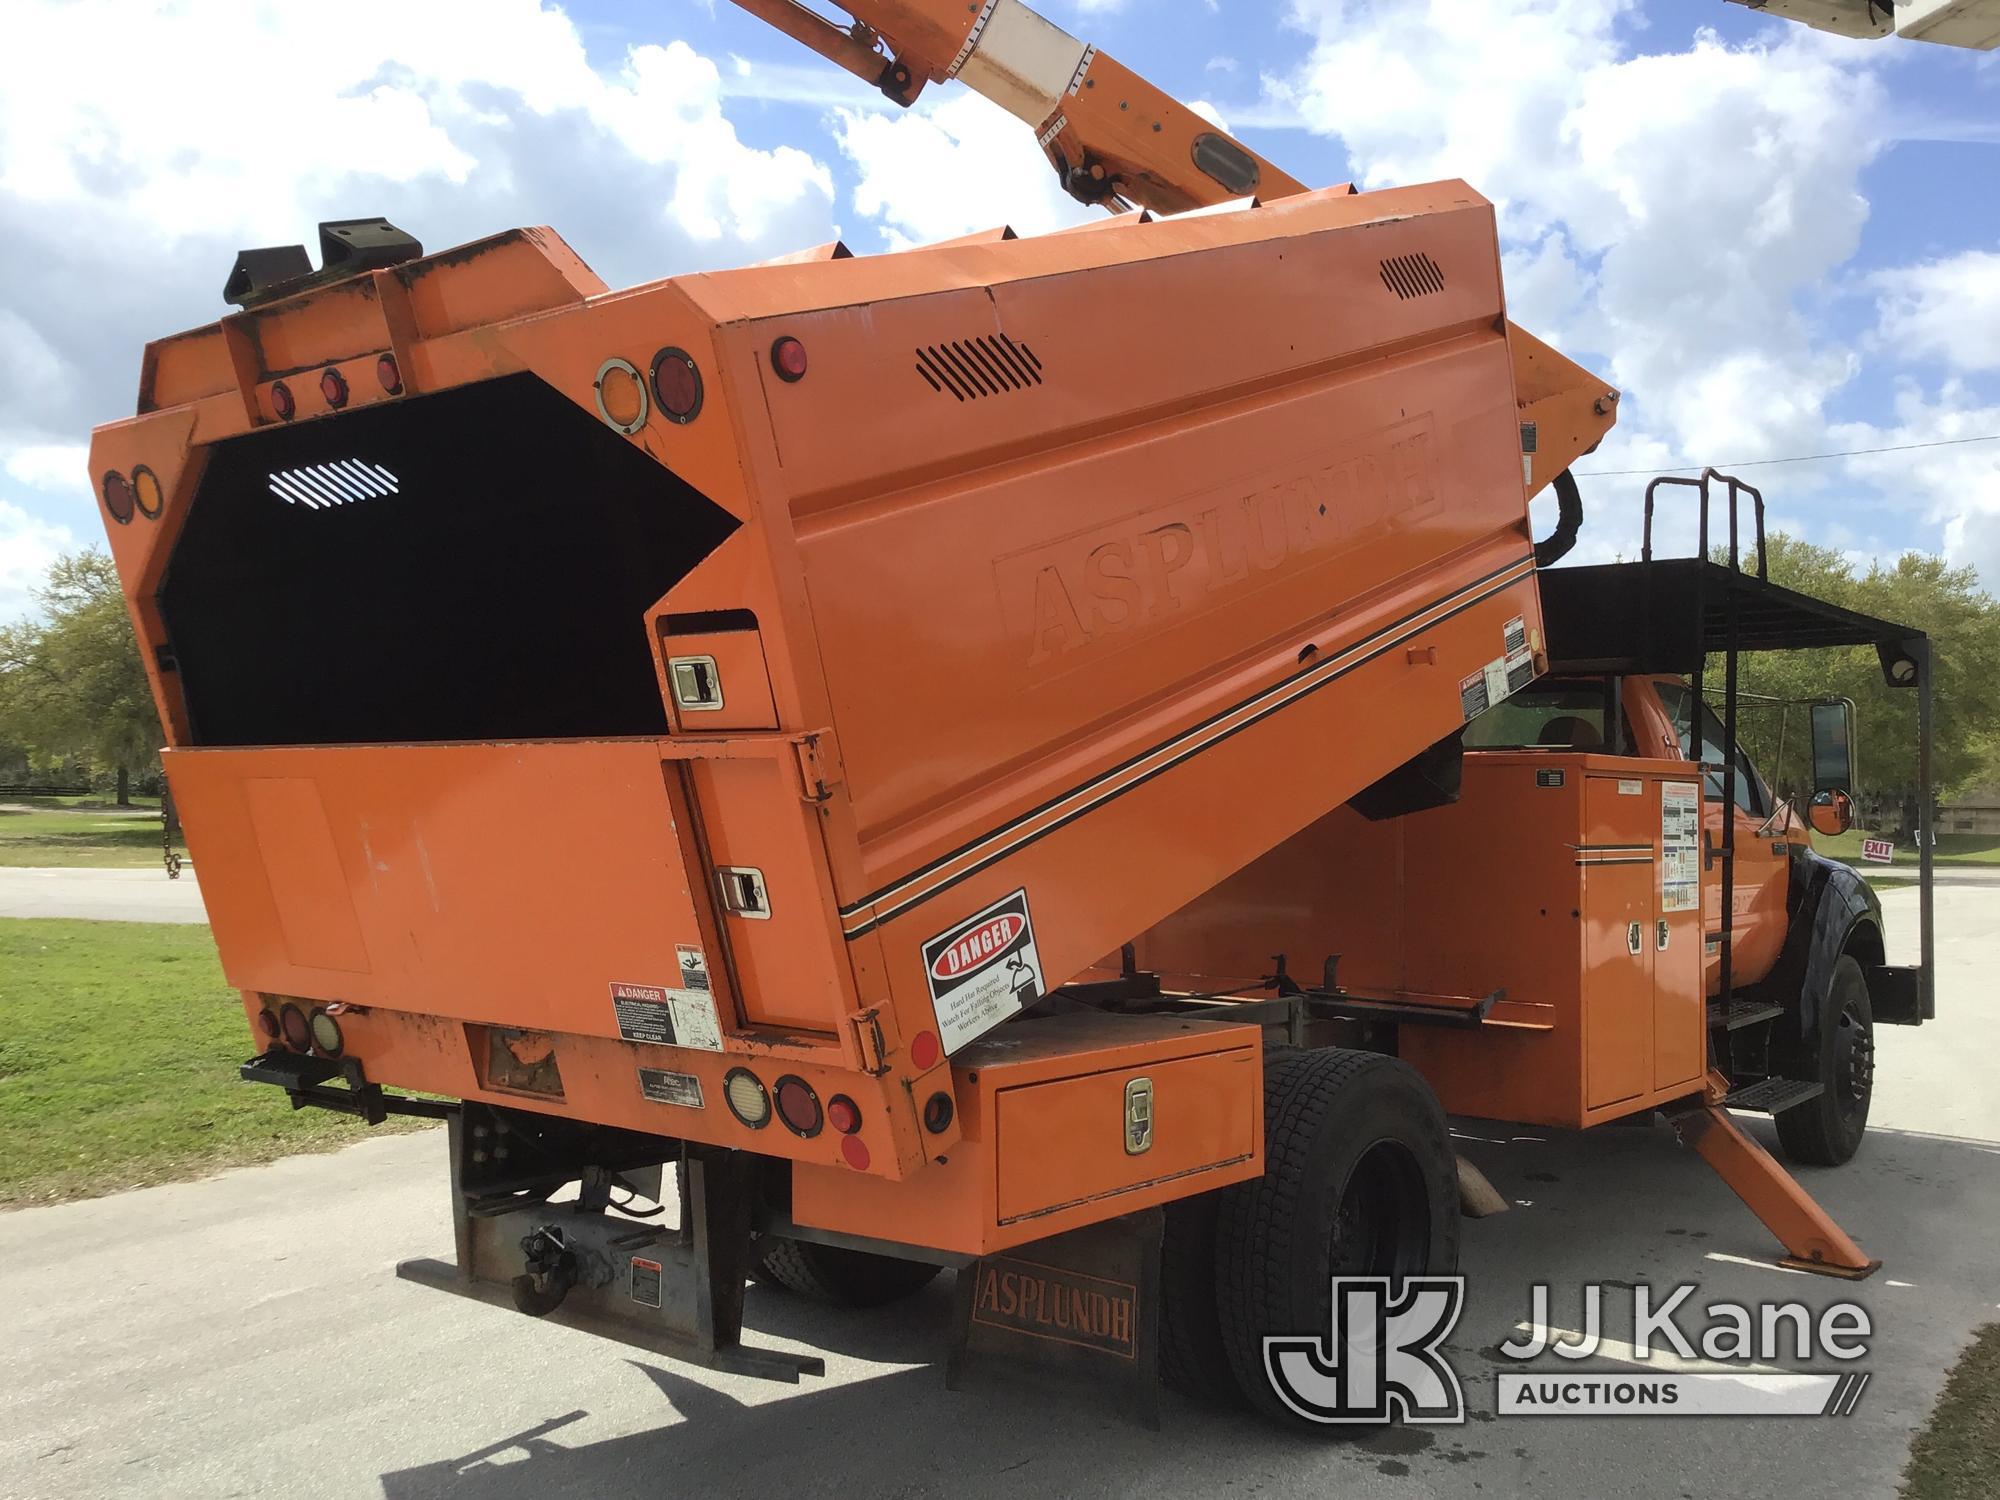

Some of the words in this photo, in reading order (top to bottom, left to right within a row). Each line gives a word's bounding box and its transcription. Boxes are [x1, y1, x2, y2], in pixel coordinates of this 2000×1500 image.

[1026, 431, 1437, 668] ASPLUNDH
[1864, 840, 1893, 855] EXIT
[946, 918, 1012, 973] DANGER
[625, 988, 661, 1001] DANGER
[941, 1014, 960, 1028] Watch
[959, 1007, 970, 1018] For
[989, 983, 1010, 999] Objects
[950, 996, 965, 1011] Hard
[964, 991, 976, 1001] Hat
[975, 973, 1000, 995] Required
[645, 1033, 662, 1041] CLEAR
[957, 1015, 981, 1031] Workers
[979, 1268, 1131, 1344] ASPLUNDH
